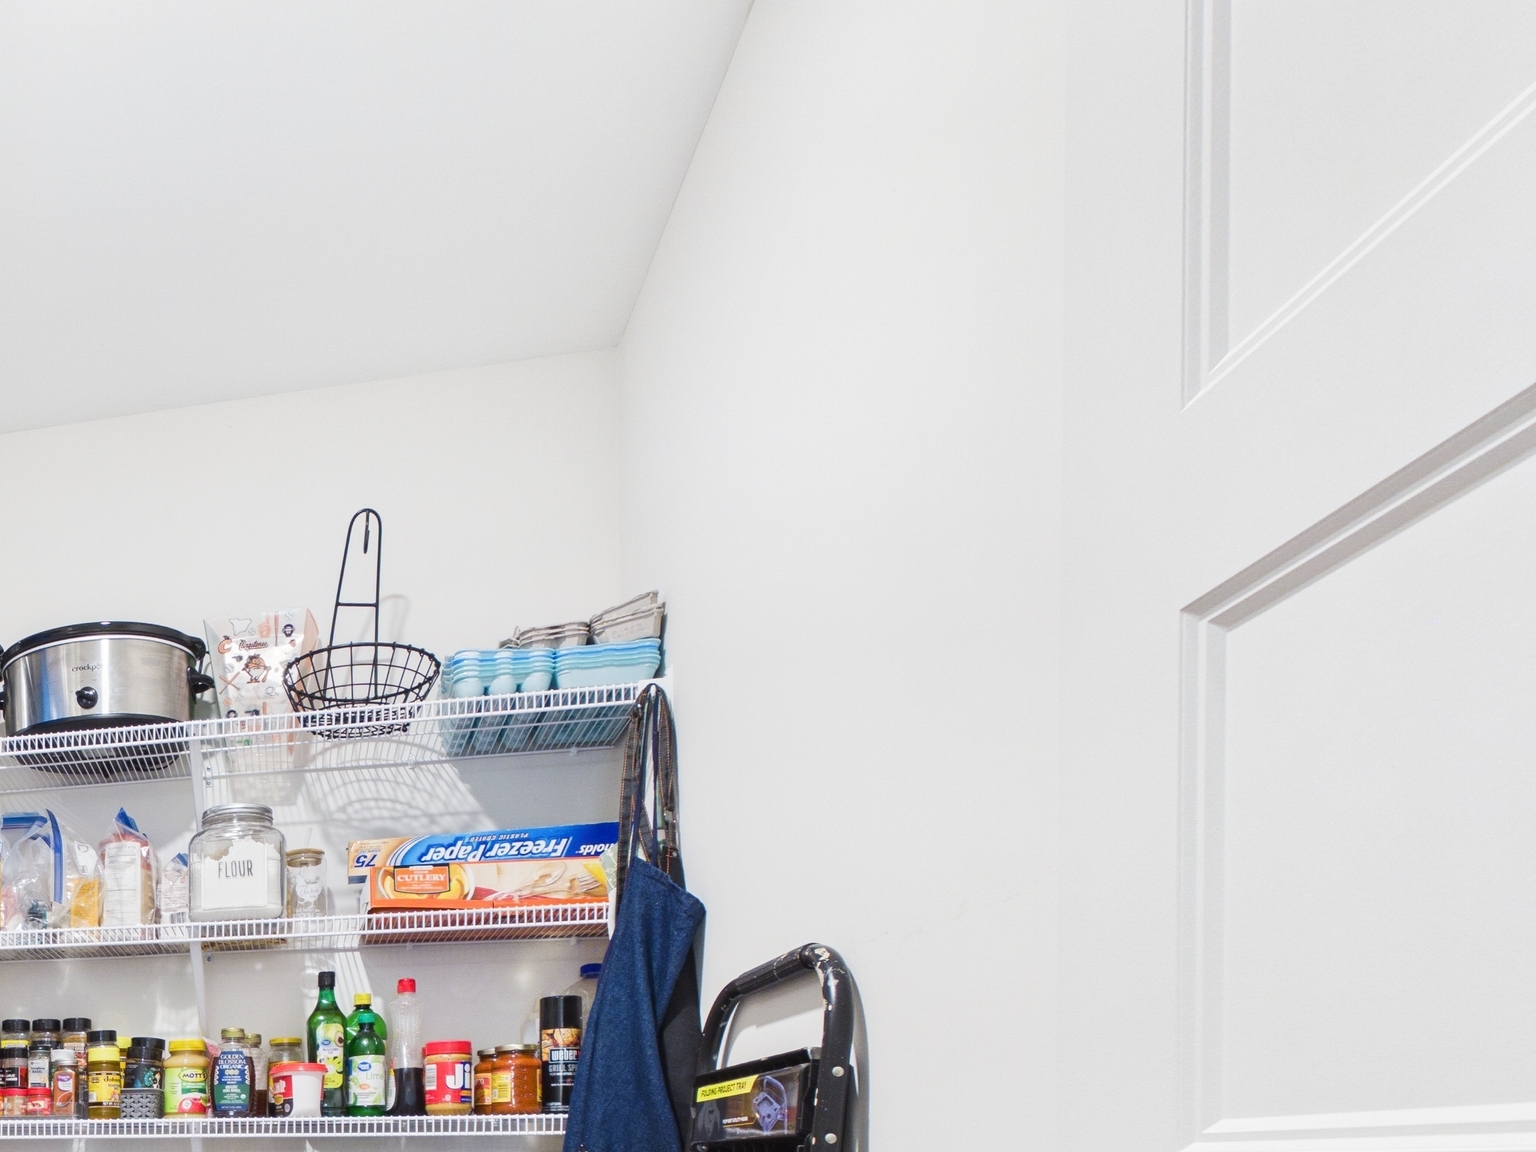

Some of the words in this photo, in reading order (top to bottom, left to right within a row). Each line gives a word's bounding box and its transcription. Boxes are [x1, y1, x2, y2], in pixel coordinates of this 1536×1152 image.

[421, 840, 486, 862] Paper
[486, 838, 567, 857] Freezer
[217, 859, 254, 879] FLOUR
[354, 854, 378, 868] 75
[552, 1050, 578, 1061] weber
[548, 1064, 566, 1072] GRILL
